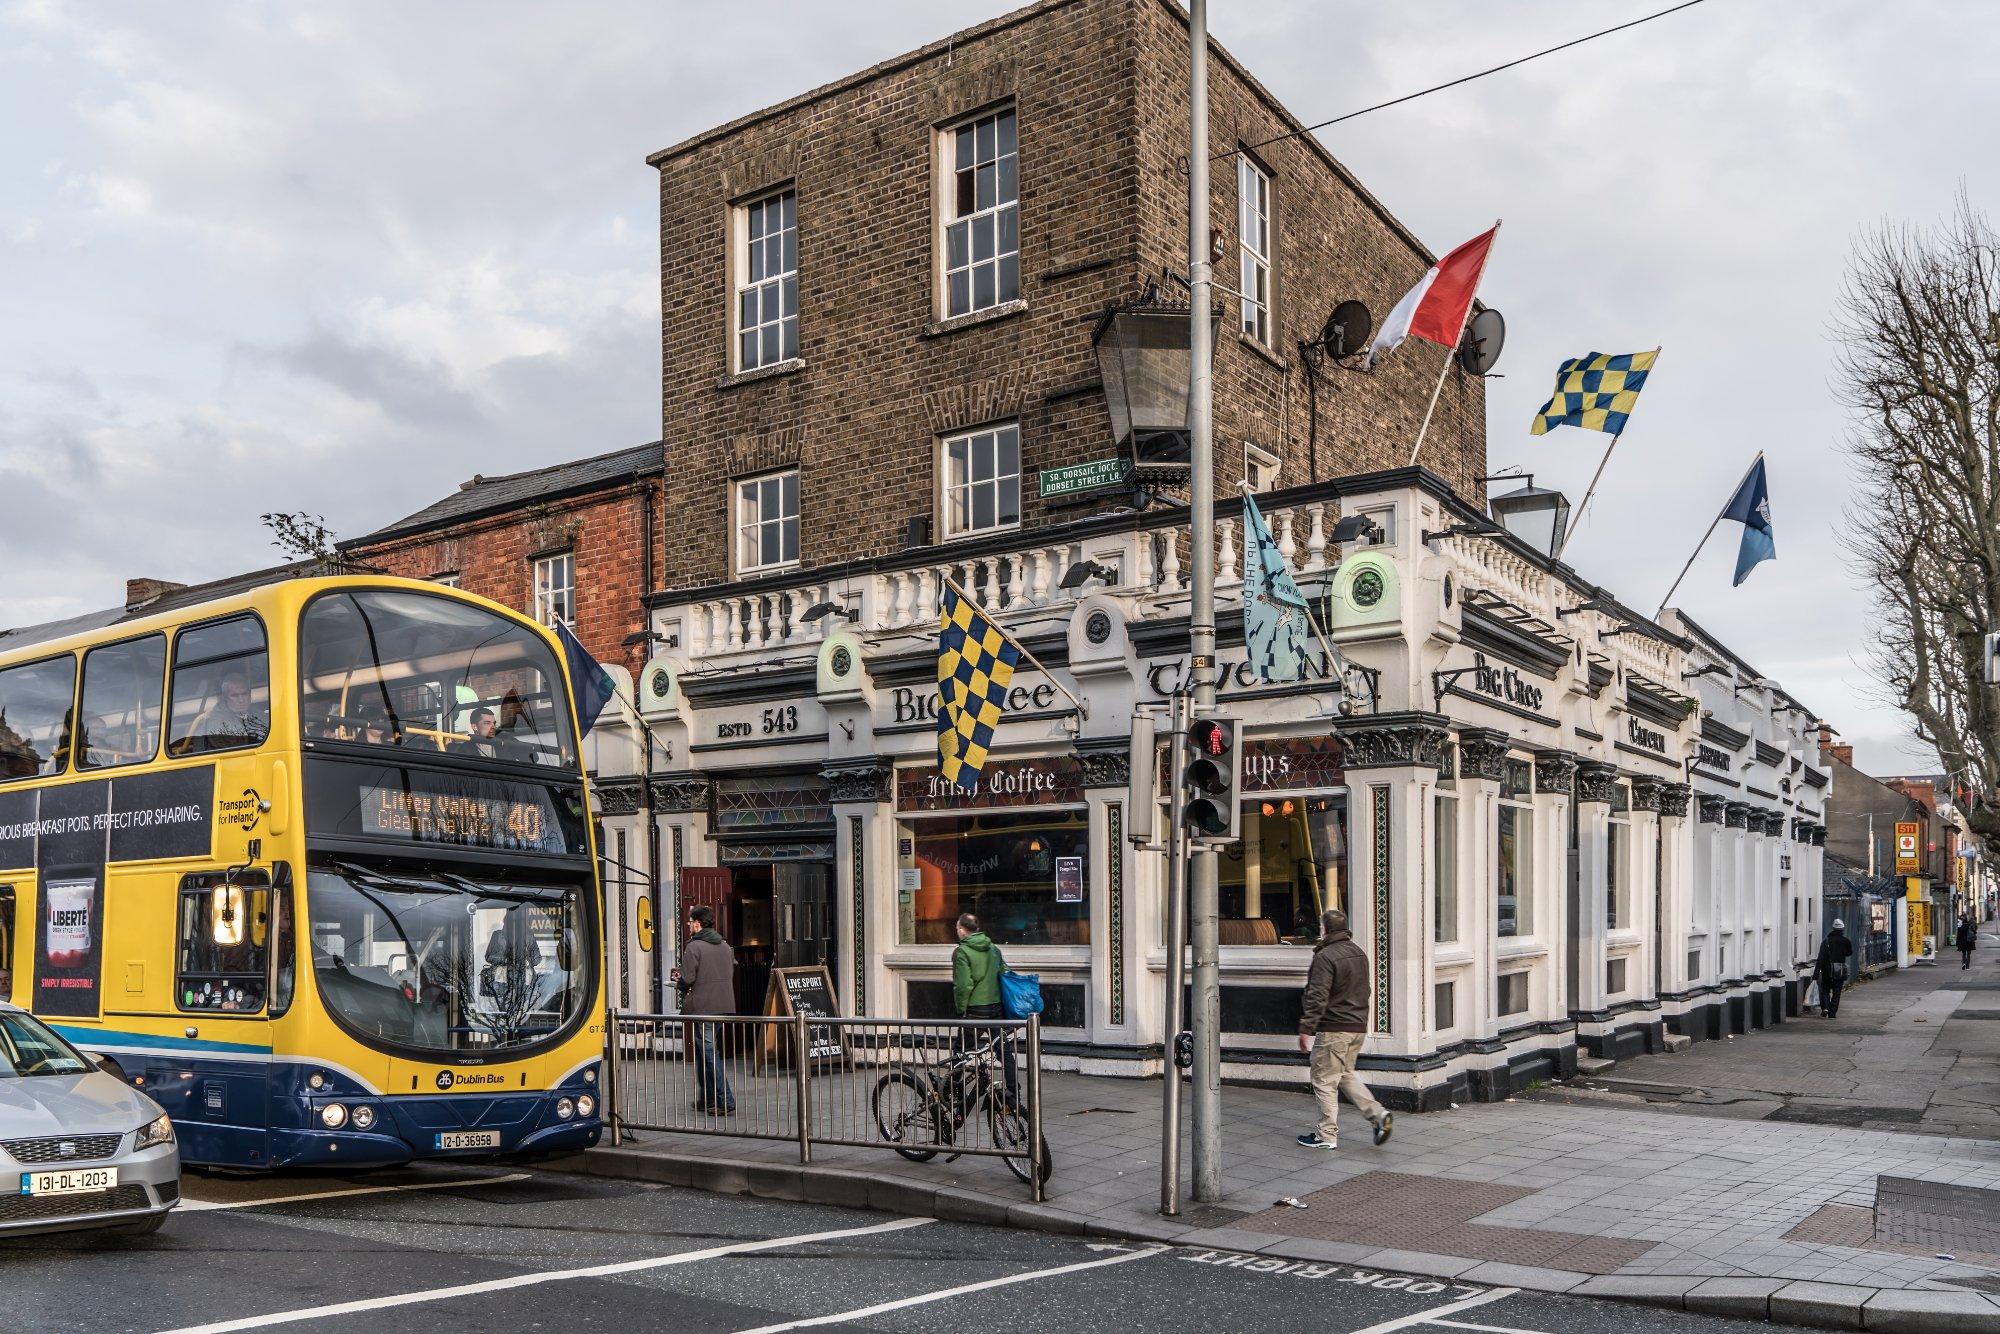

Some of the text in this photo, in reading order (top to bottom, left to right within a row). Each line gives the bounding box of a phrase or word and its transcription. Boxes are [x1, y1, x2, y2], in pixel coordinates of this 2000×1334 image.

[1046, 480, 1074, 491] DORSET
[717, 706, 799, 739] ESTD 543
[989, 769, 1056, 795] Coffee
[219, 798, 255, 811] Transport
[438, 796, 487, 818] Valley
[22, 818, 67, 838] BREAKFAST
[67, 815, 91, 833] POTS.
[93, 812, 133, 830] PERFECT
[133, 810, 153, 827] FOR
[154, 804, 203, 825] SHARING.
[218, 811, 254, 824] for Ireland
[508, 803, 540, 842] 40
[1900, 824, 1915, 833] 511
[52, 907, 87, 926] LIBERTÉ
[41, 978, 93, 989] SIMPLY IRRESISTIBLE
[787, 976, 822, 989] LIVE SPORT
[456, 1073, 505, 1085] Dublin Bus
[443, 1134, 492, 1147] 12-D-36958
[39, 1171, 108, 1191] 131-DL-1203
[1178, 1251, 1485, 1300] LOOK RIGHT
